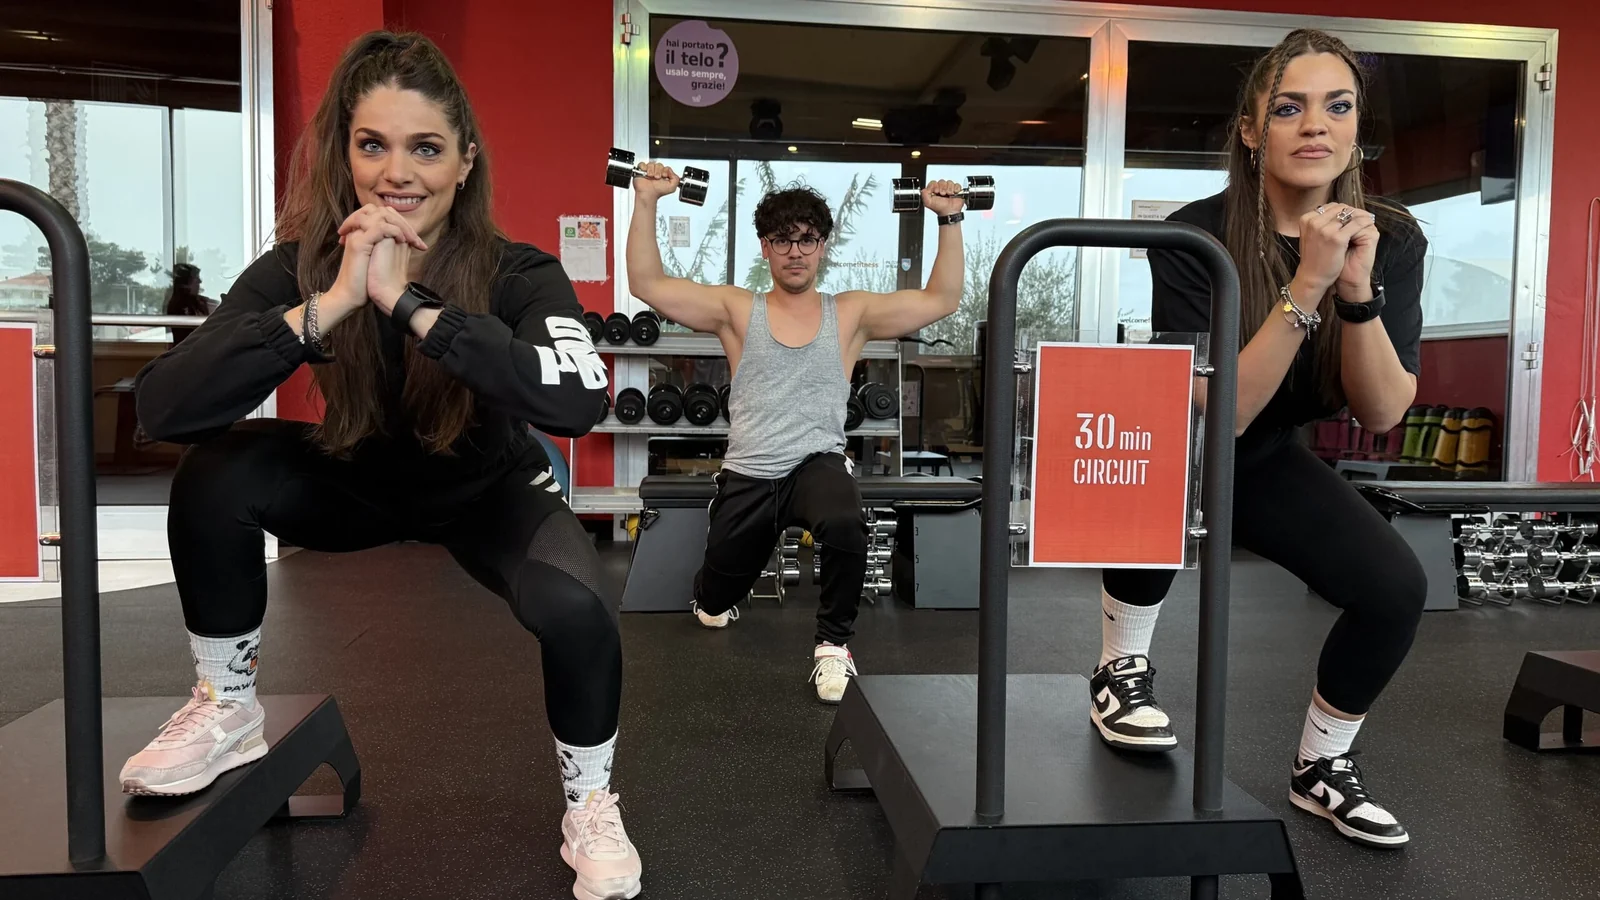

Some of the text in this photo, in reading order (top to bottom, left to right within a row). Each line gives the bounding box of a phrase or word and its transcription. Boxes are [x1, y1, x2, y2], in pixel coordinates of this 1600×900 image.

[666, 39, 715, 50] hai portato
[666, 50, 675, 65] il
[665, 68, 727, 80] usalo sempre,
[691, 81, 725, 90] grazie!
[1075, 413, 1152, 451] 30 min
[1073, 458, 1150, 485] CIRCUIT
